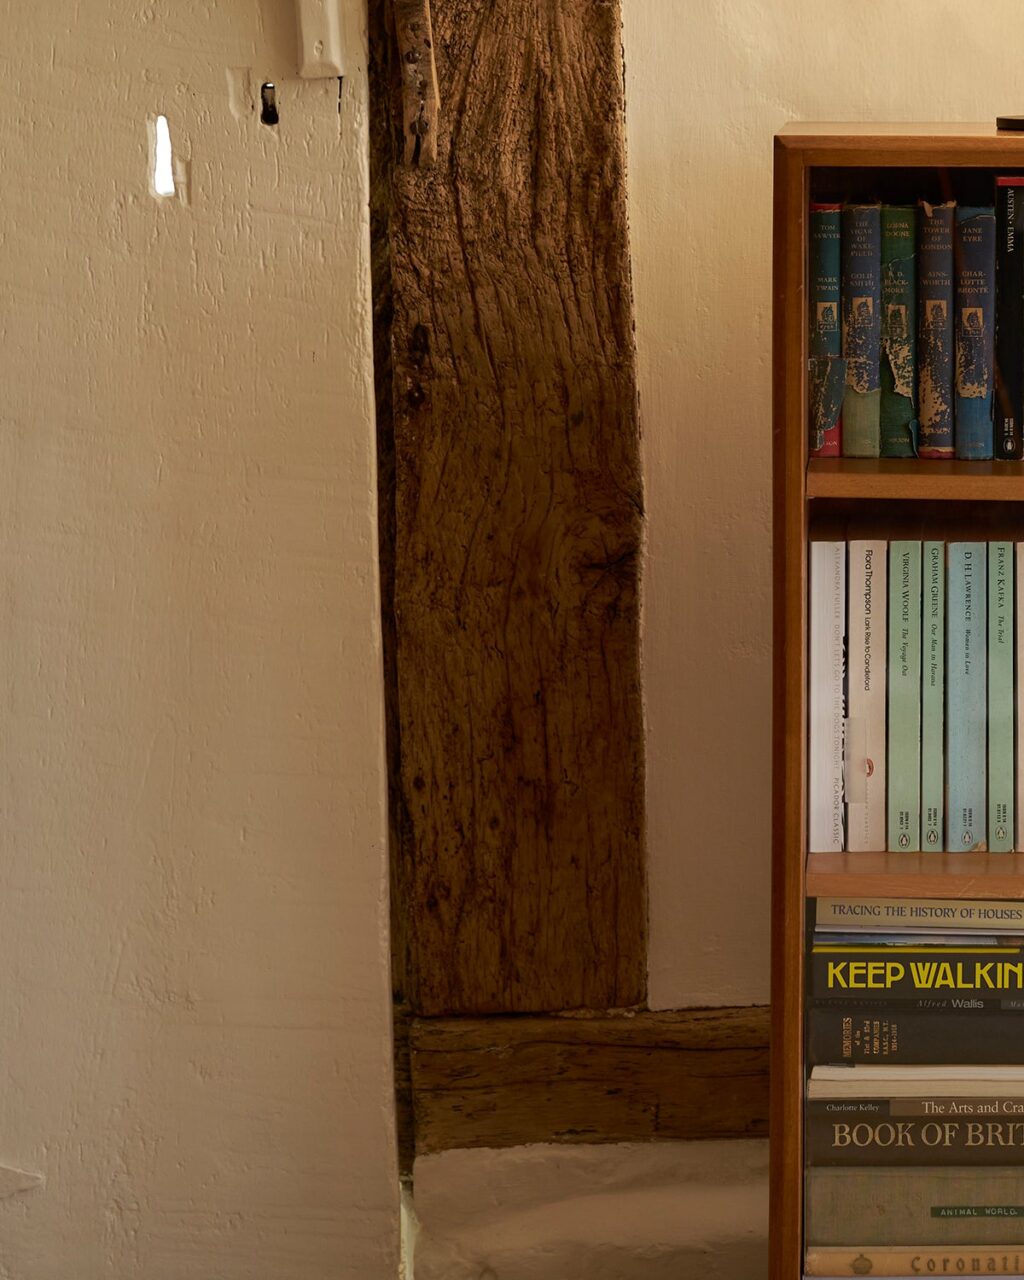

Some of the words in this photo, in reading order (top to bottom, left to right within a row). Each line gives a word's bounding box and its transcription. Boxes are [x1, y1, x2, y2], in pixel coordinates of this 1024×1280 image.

[864, 549, 873, 569] Flora
[862, 570, 873, 615] Thompson
[831, 904, 881, 918] TRACING
[884, 906, 907, 918] THE
[910, 906, 956, 919] HISTORY
[960, 908, 975, 919] OF
[978, 908, 1022, 920] HOUSES
[827, 961, 904, 989] KEEP
[951, 999, 984, 1009] Wallis
[922, 1102, 944, 1112] The
[948, 1102, 974, 1112] Arts
[978, 1102, 999, 1112] and
[832, 1122, 915, 1147] BOOK
[921, 1122, 957, 1147] OF
